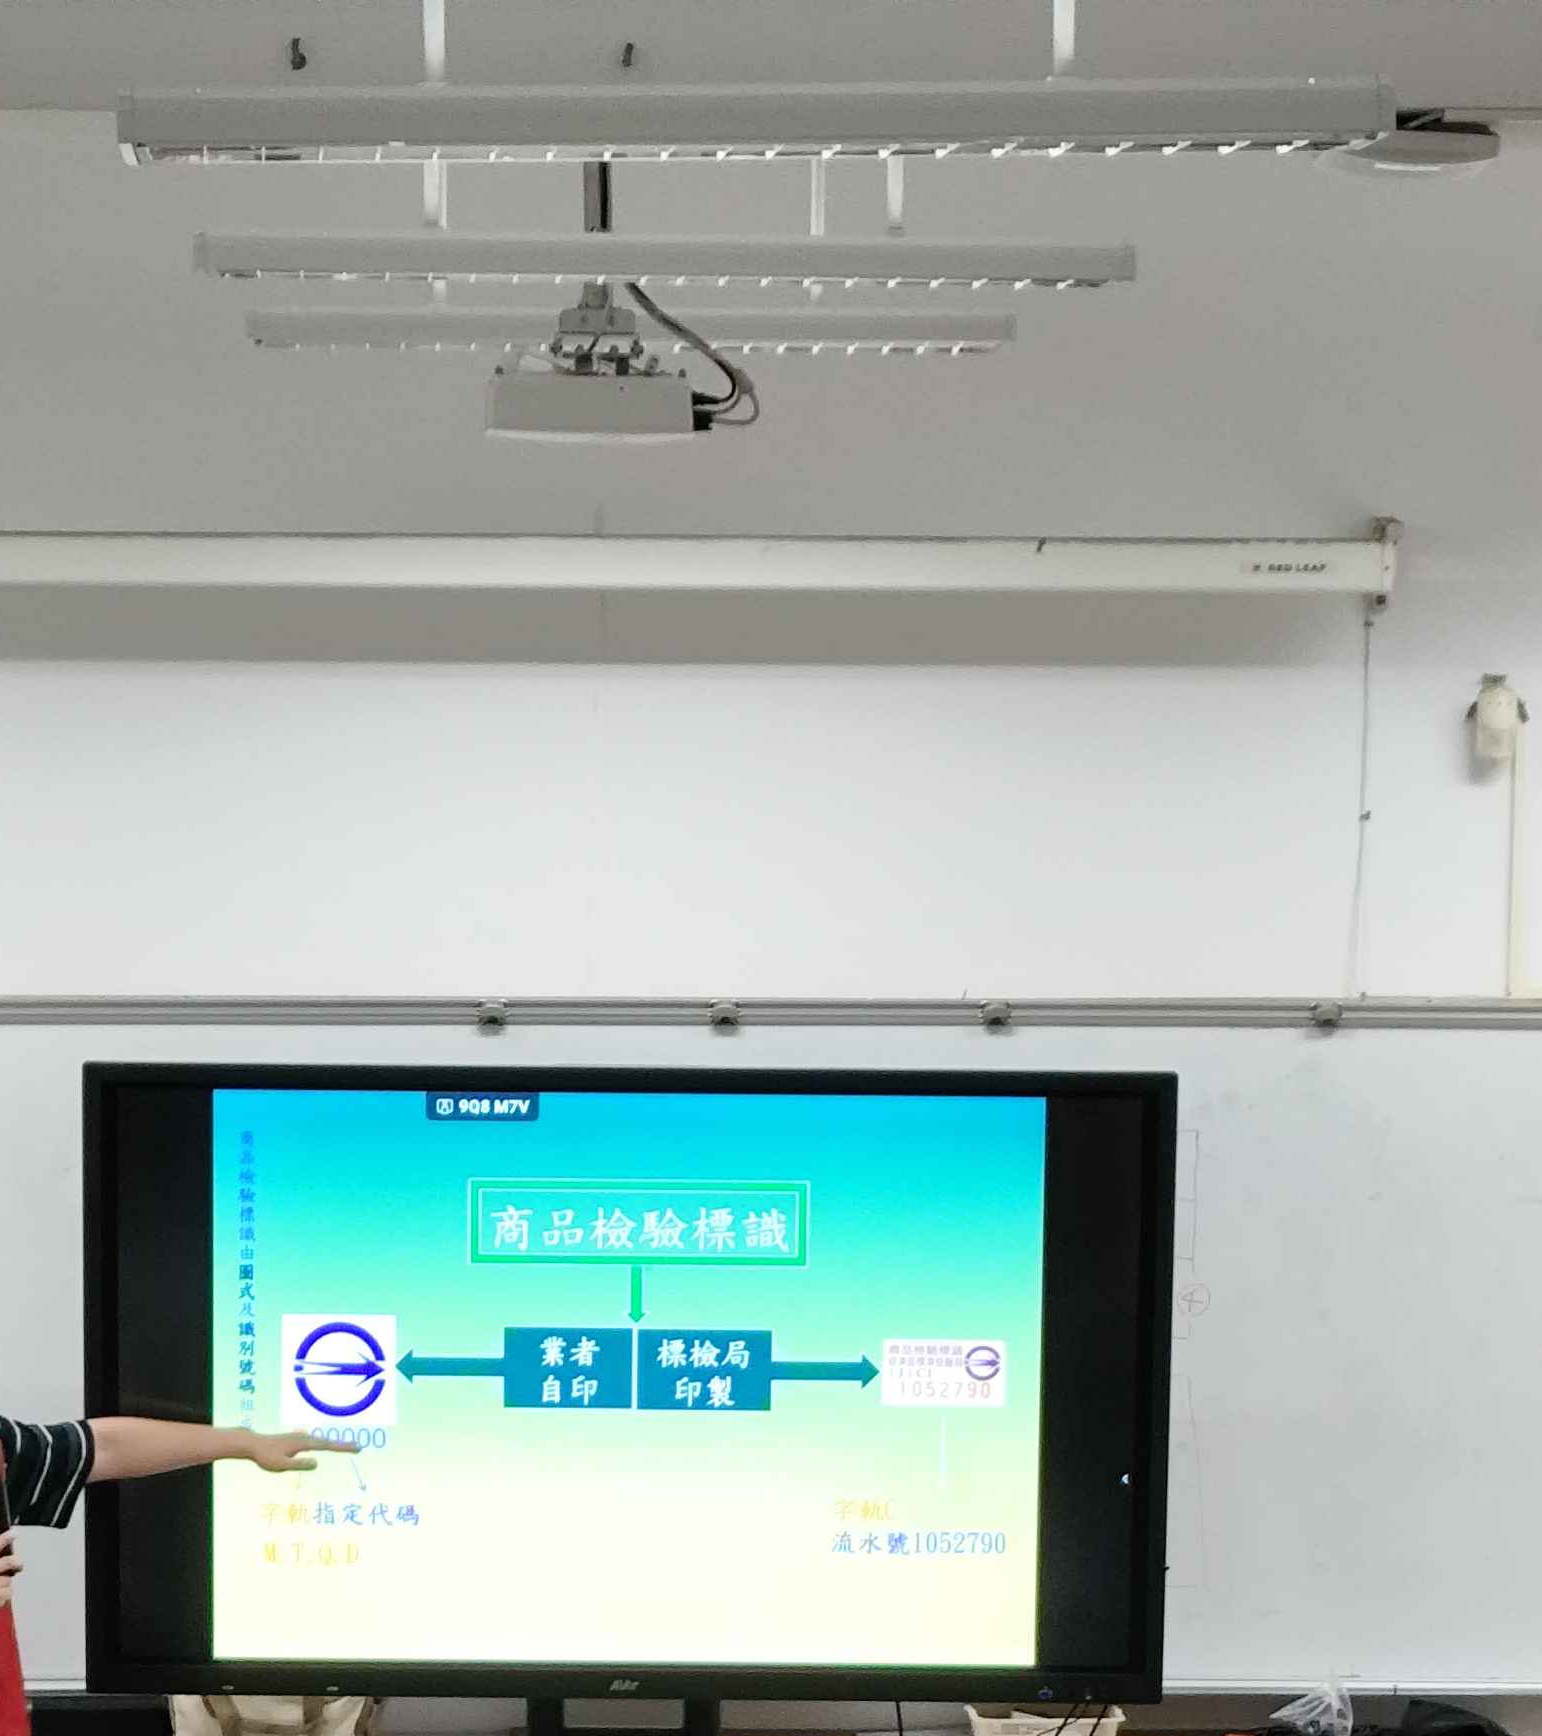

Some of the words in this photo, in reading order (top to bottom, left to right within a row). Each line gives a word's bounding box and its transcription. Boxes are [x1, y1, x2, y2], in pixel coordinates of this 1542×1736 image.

[490, 1204, 791, 1254] 商品檢驗標識
[539, 1335, 601, 1368] 業者
[656, 1339, 751, 1370] 標檢局
[540, 1374, 600, 1407] 自印
[674, 1376, 736, 1408] 印製
[900, 1381, 991, 1399] 1052790
[831, 1531, 1007, 1555] 流水號1052790
